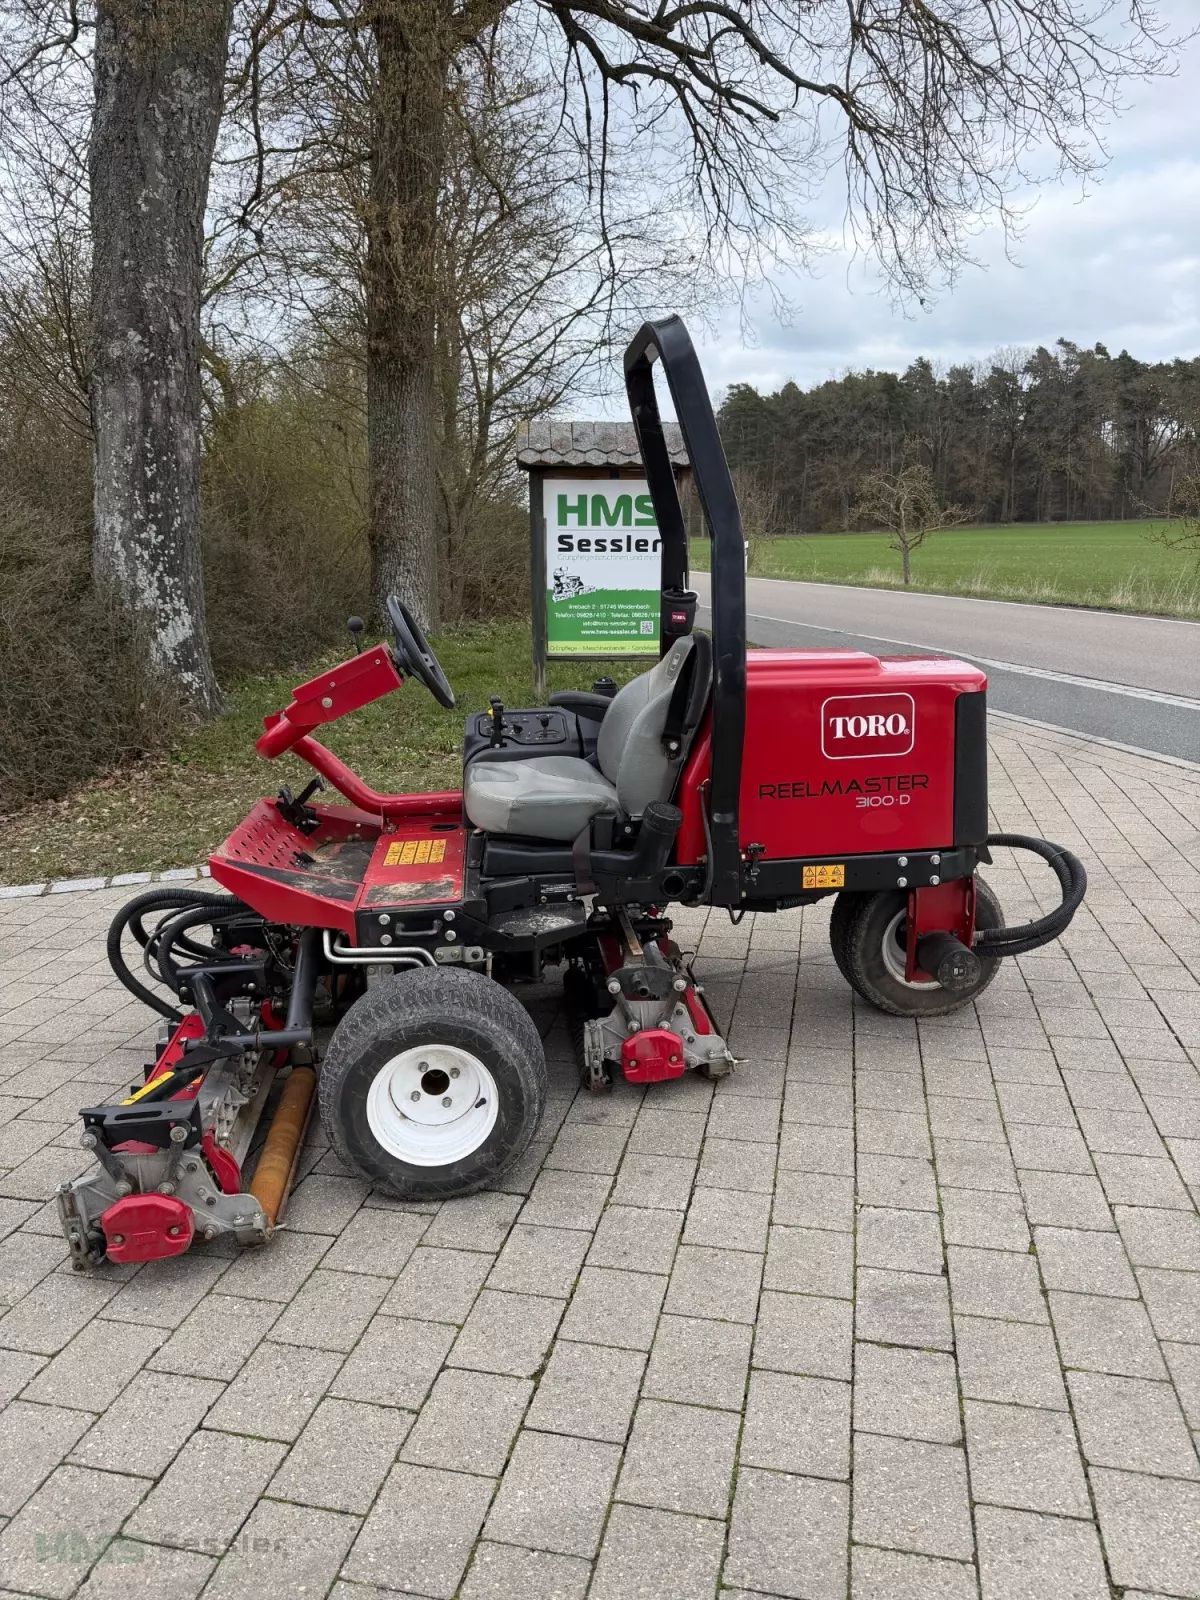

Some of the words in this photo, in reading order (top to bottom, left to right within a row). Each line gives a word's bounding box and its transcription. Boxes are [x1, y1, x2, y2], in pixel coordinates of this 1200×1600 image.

[557, 493, 658, 527] HMS
[557, 534, 663, 553] Sessler
[829, 712, 907, 739] TORO
[758, 774, 930, 800] REELMASTER
